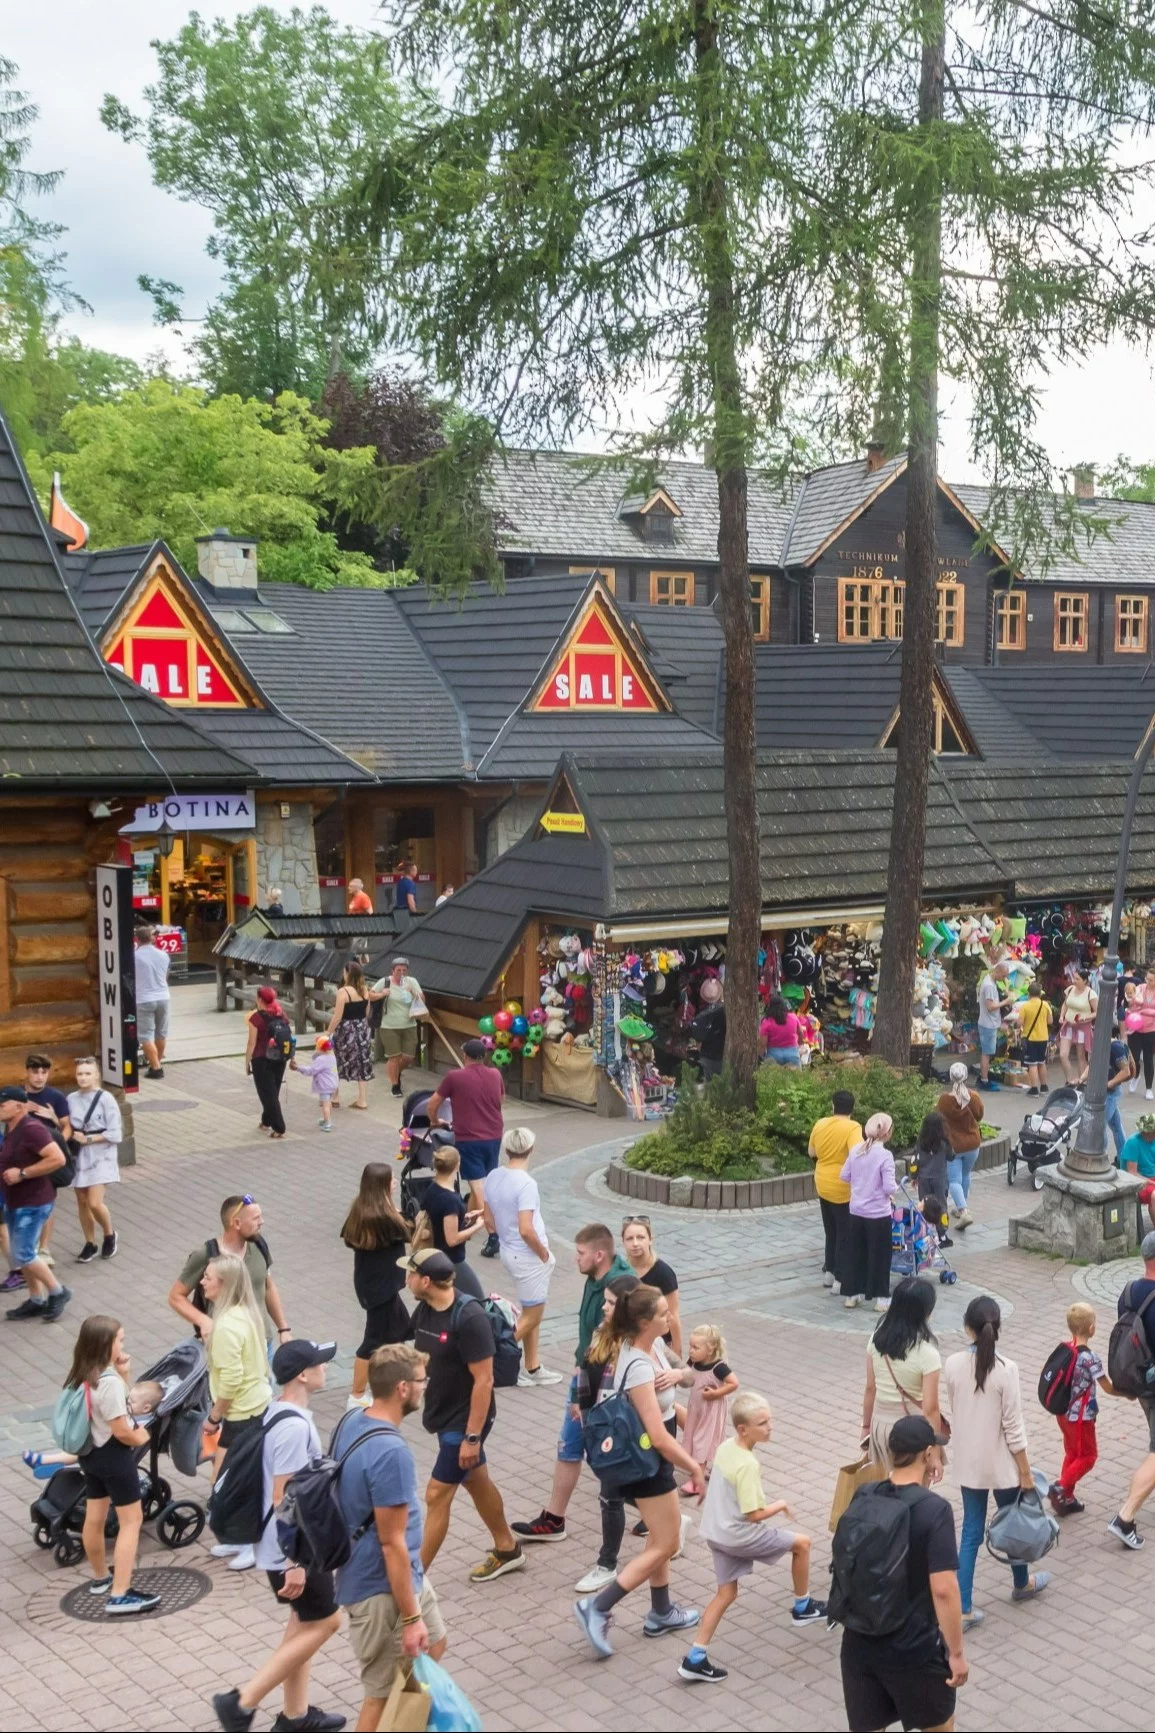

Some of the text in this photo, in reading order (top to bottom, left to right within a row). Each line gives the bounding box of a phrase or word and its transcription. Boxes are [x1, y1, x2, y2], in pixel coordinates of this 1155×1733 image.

[838, 551, 899, 563] TECHNIKUM
[853, 566, 883, 580] 1876
[555, 673, 633, 700] SALE
[149, 801, 250, 818] BOTINA
[102, 884, 117, 1073] OBUWIE
